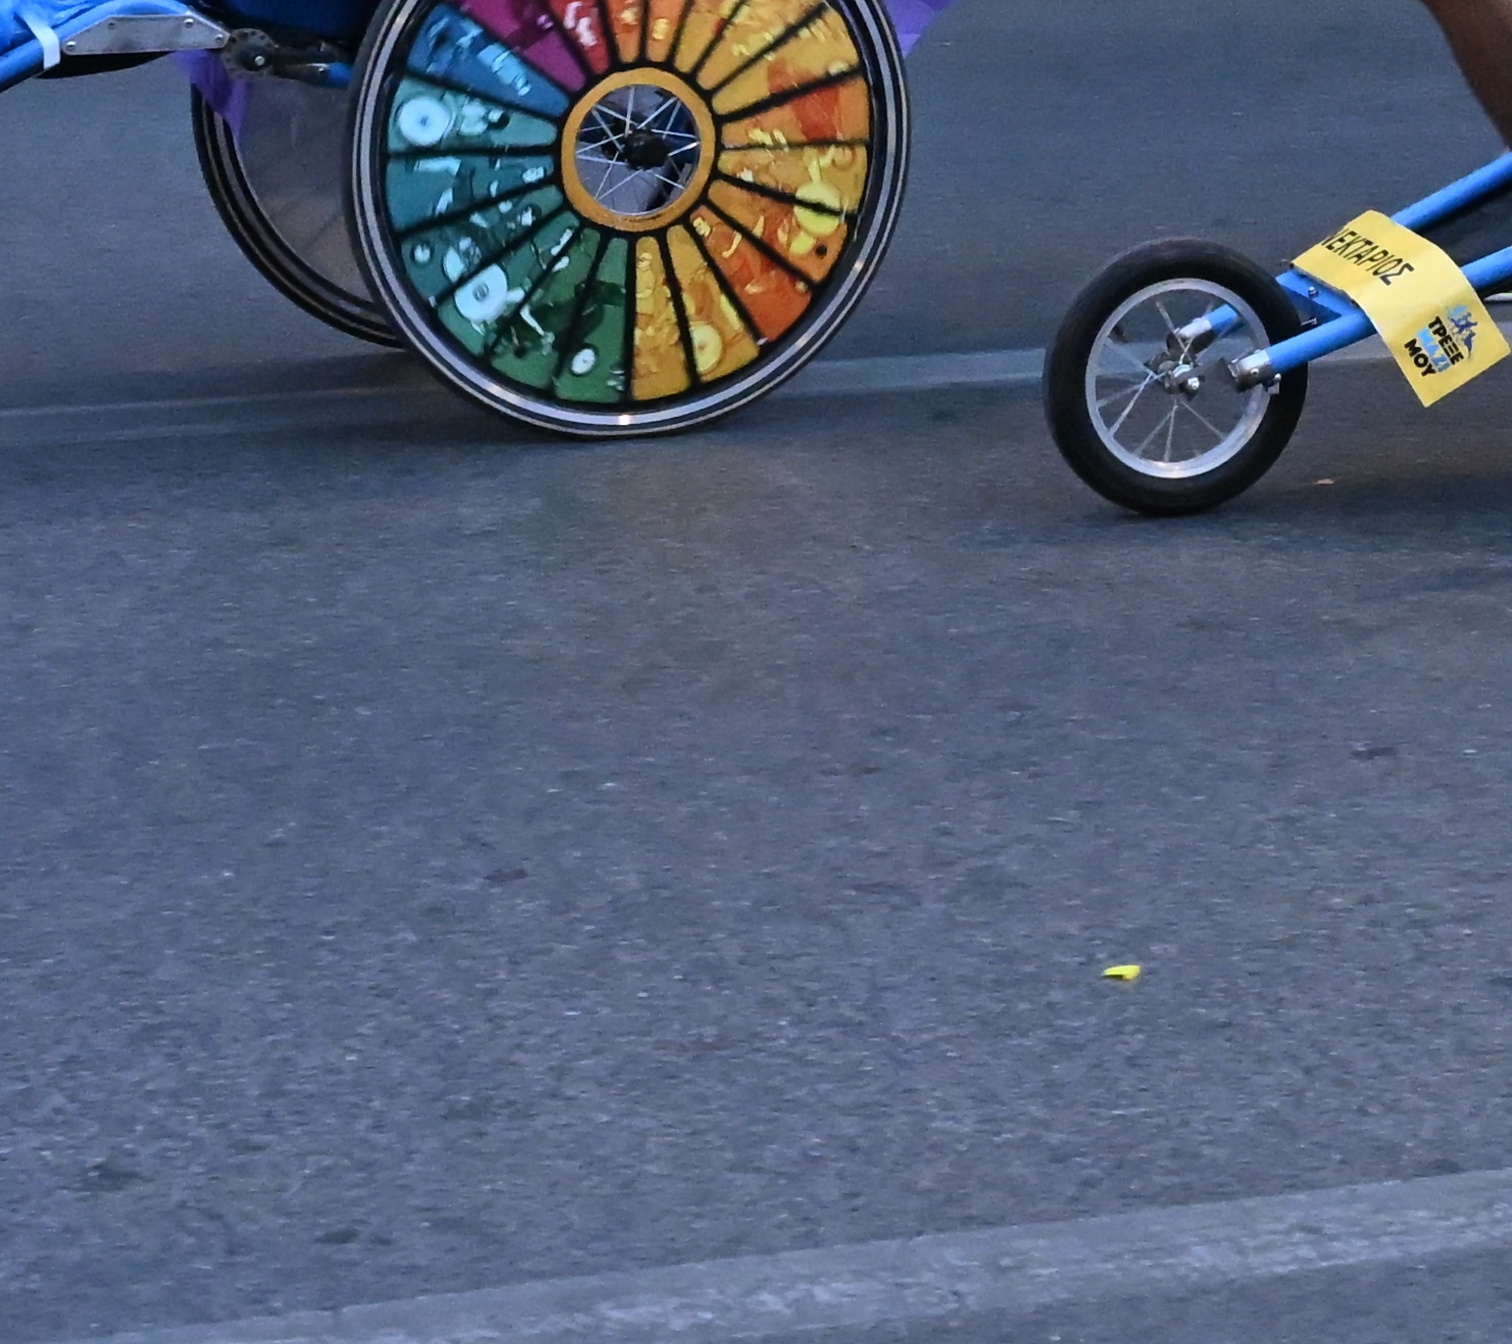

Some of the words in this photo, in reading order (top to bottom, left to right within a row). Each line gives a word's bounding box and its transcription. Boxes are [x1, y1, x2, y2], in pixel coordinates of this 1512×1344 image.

[1402, 337, 1437, 378] ΜΟΥ
[1415, 326, 1451, 374] ΜΑΖΙ
[1427, 315, 1464, 366] ΤΡΕΞΕ
